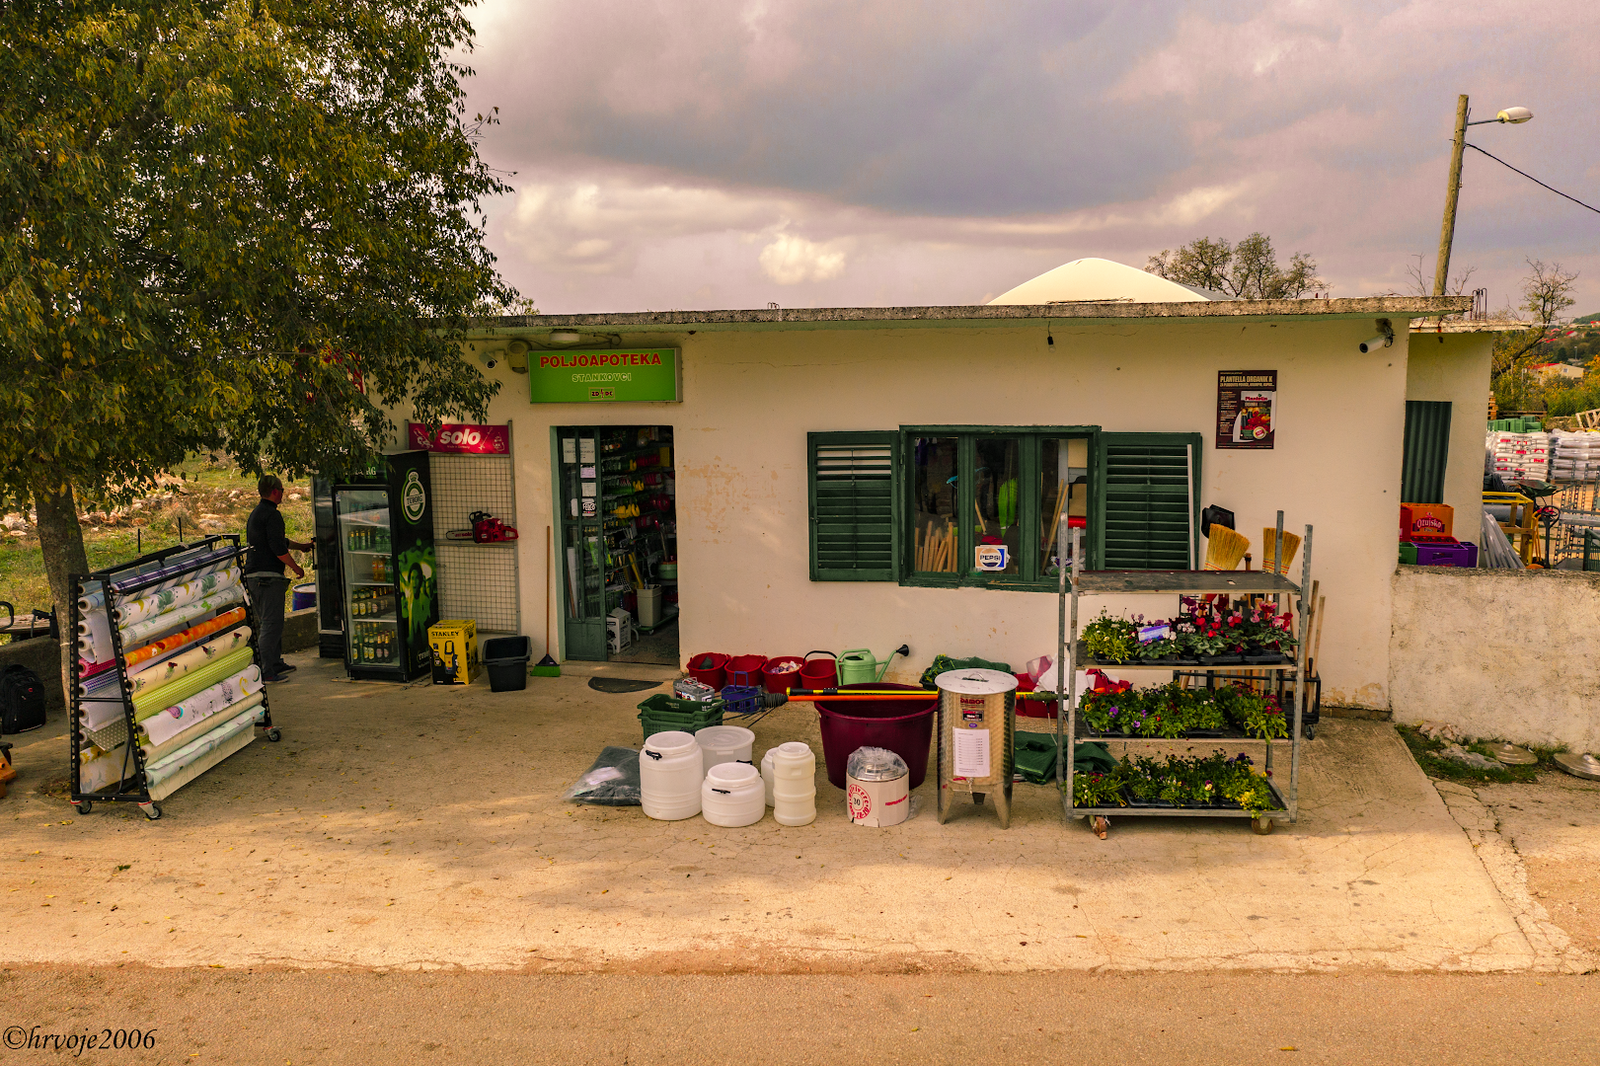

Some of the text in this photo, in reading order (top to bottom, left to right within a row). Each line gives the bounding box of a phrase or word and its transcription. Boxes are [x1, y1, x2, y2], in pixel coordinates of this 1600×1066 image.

[540, 353, 662, 368] POLJOAPOTEKA
[572, 373, 632, 382] STANKOVCI
[440, 428, 481, 445] solo
